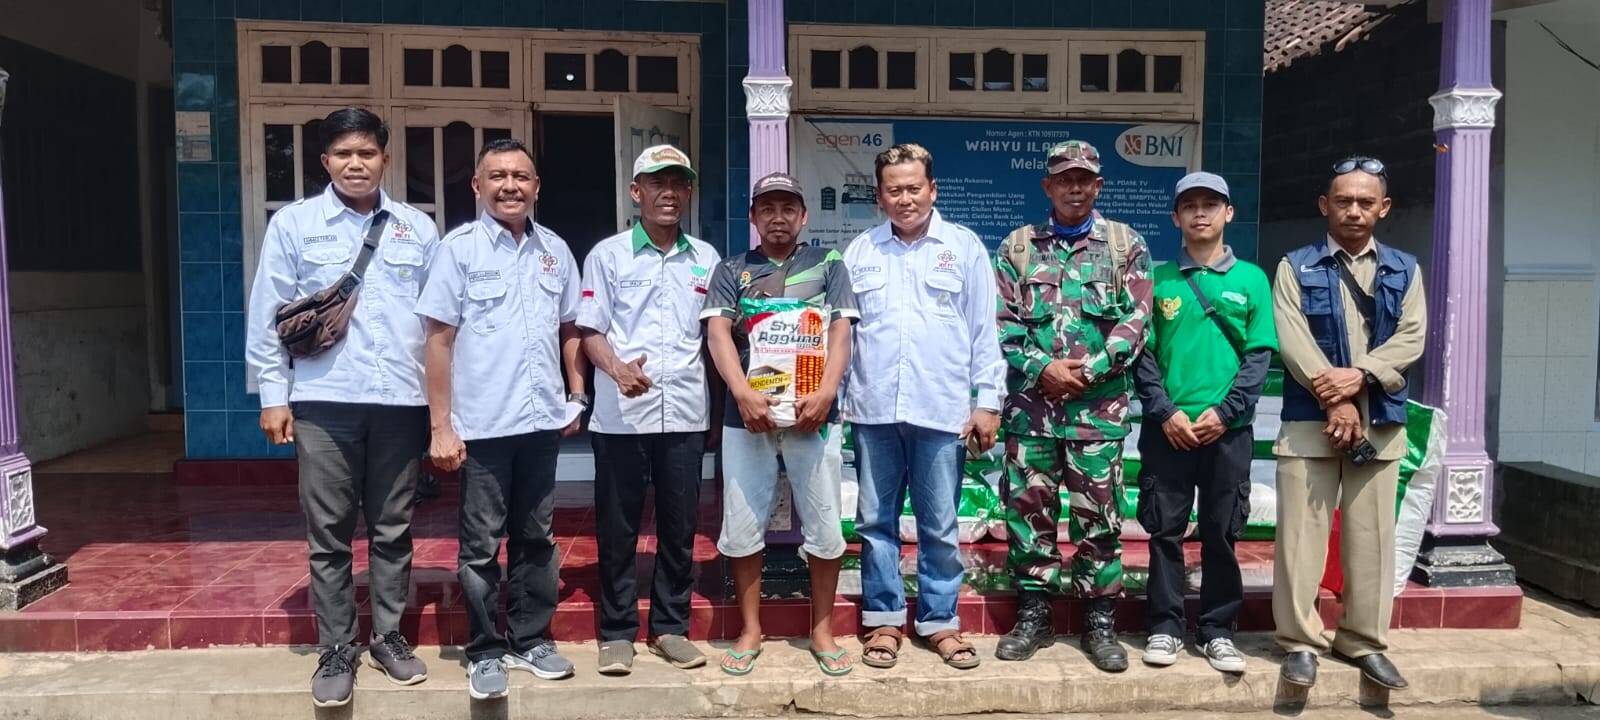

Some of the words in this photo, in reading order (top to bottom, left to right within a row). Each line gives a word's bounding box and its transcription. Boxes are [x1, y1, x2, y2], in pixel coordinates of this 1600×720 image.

[985, 129, 1007, 137] Nomor
[1008, 129, 1024, 139] Agen
[965, 140, 1020, 152] WAHYU
[1027, 141, 1056, 152] ILA
[1145, 135, 1183, 156] BNI
[770, 321, 800, 334] Sry
[758, 331, 823, 347] Aggung
